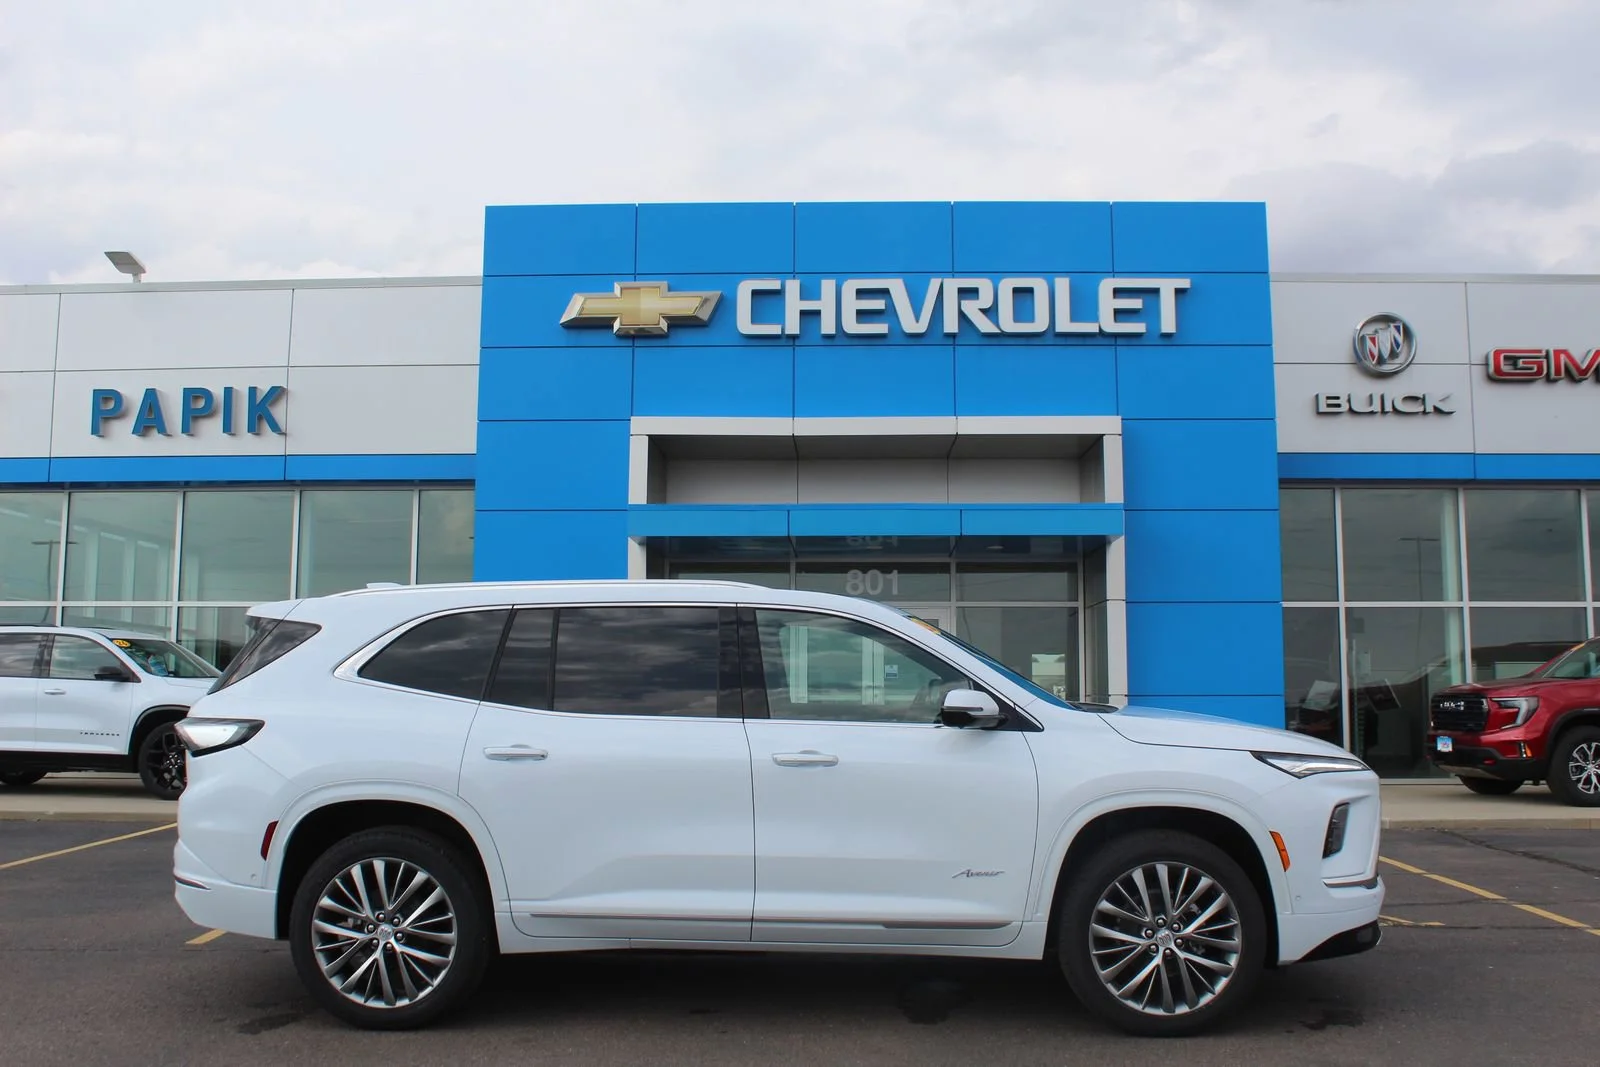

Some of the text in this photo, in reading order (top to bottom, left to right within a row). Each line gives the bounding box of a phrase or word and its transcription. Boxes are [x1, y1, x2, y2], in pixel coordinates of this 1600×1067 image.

[737, 277, 1191, 334] CHEVROLET
[1487, 348, 1600, 381] GM
[91, 386, 287, 437] PAPIK
[1315, 393, 1456, 415] BUICK
[846, 569, 898, 595] 801
